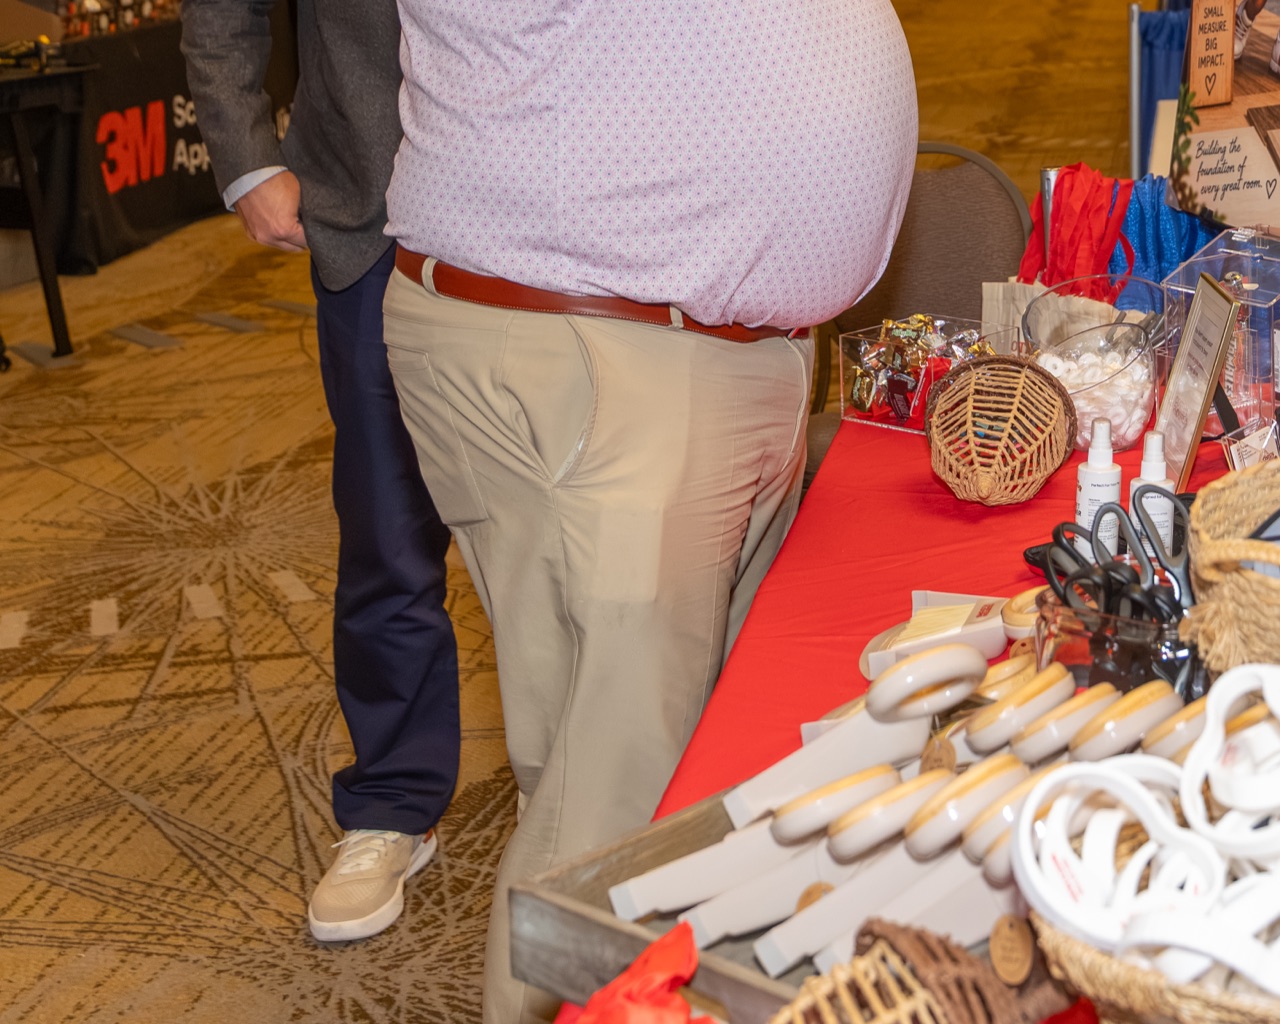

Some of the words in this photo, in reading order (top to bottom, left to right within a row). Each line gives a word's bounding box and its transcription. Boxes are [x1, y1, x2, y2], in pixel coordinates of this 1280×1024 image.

[1203, 6, 1224, 20] SMALL
[1198, 20, 1228, 35] MEASURE.
[1205, 38, 1217, 52] BIG
[1198, 54, 1224, 69] IMPACT.
[172, 94, 198, 129] Sc
[96, 98, 167, 196] 3M
[1196, 139, 1226, 162] Building
[1229, 136, 1242, 154] the
[1196, 159, 1235, 182] foundation
[1237, 155, 1248, 180] of
[1200, 184, 1219, 202] every
[1220, 178, 1242, 201] great
[1242, 180, 1263, 190] room.
